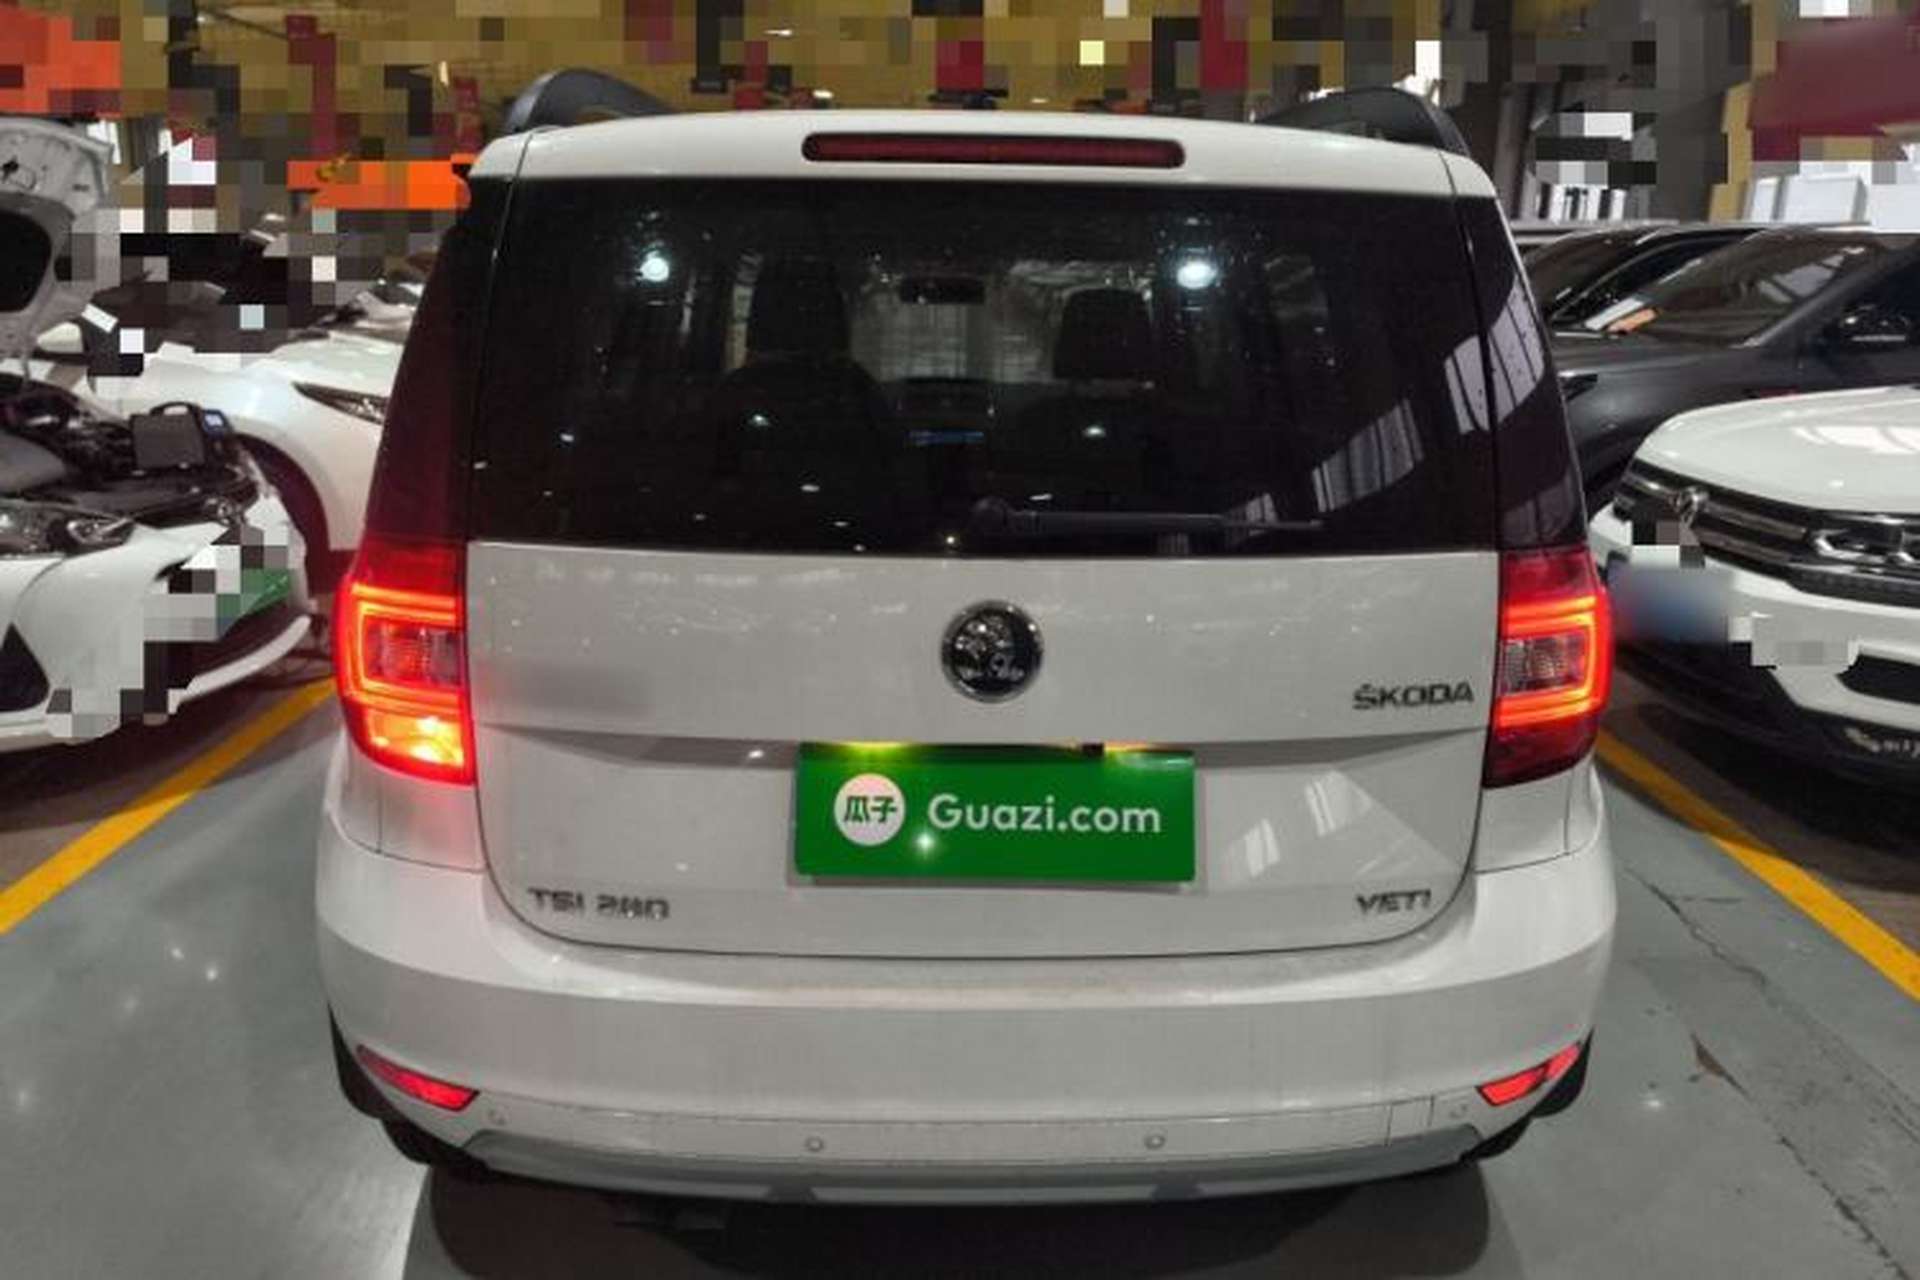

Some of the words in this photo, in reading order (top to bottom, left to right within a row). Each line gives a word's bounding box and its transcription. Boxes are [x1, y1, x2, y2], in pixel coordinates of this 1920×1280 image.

[843, 795, 897, 823] 瓜子
[927, 793, 1162, 833] Guazi.com
[1355, 889, 1431, 914] YETI
